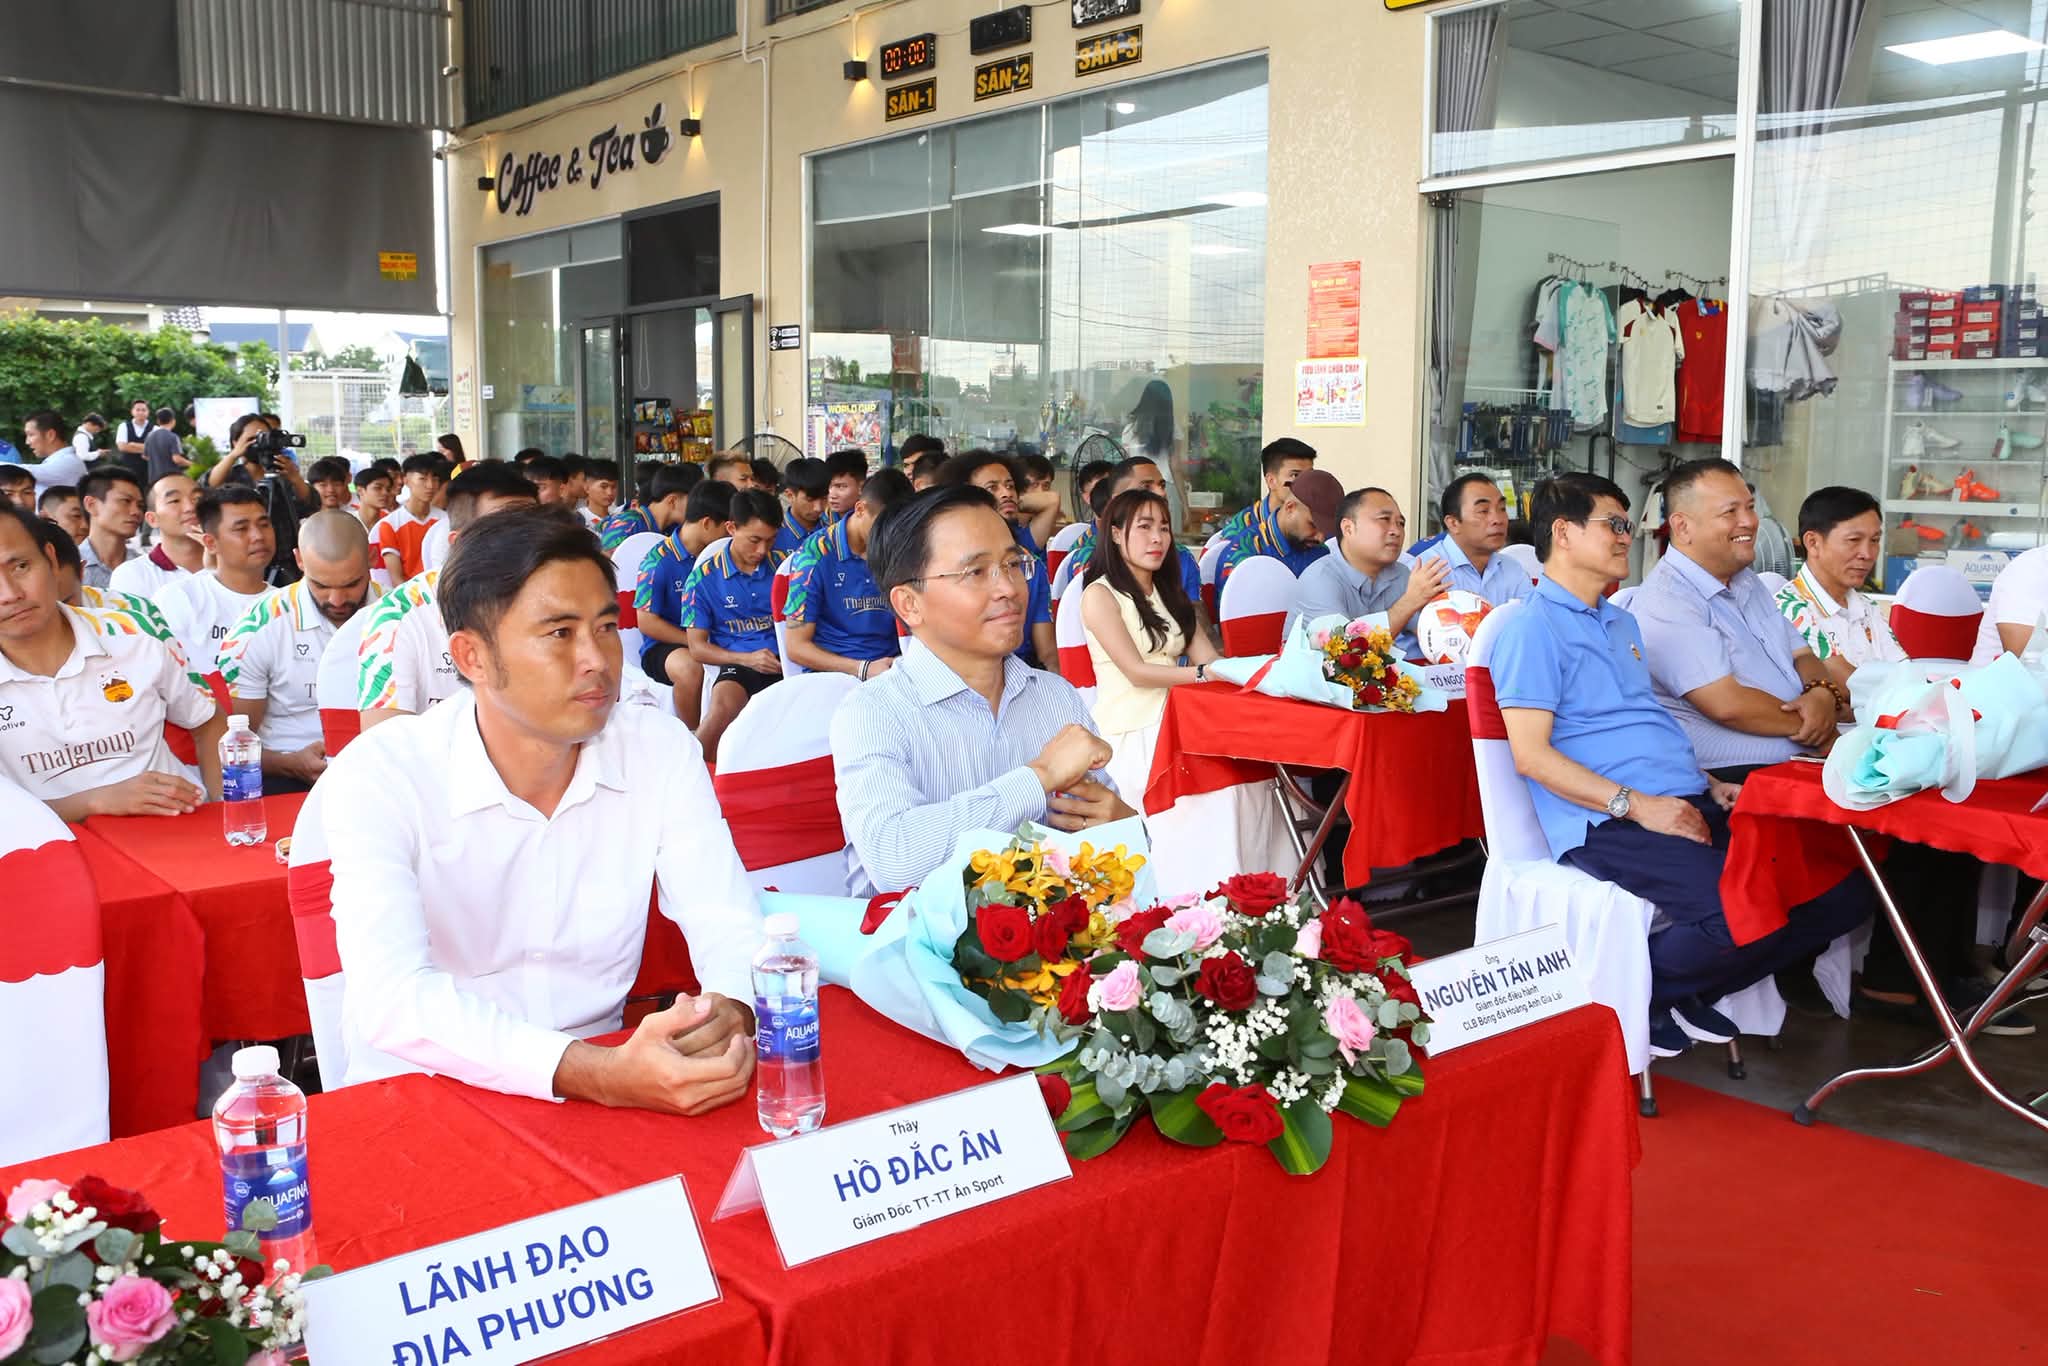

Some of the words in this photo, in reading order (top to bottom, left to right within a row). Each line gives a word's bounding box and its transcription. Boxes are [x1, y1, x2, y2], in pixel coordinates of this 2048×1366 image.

[885, 40, 925, 73] 00:00
[1078, 36, 1138, 71] SÂN-3
[976, 63, 1030, 95] SÂN-2
[888, 87, 934, 116] SÂN-1
[497, 152, 562, 216] Coffee
[566, 147, 583, 184] &
[589, 124, 636, 190] Tea
[828, 403, 858, 414] WORLD
[858, 403, 877, 413] CUP
[1424, 969, 1498, 1012] NGUYỄN
[1497, 957, 1534, 988] TẤN
[1536, 949, 1571, 977] ANH
[1462, 1018, 1478, 1031] CLB
[1528, 998, 1542, 1008] Anh
[1541, 994, 1553, 1005] Gia
[833, 1158, 882, 1202] HỒ
[887, 1141, 953, 1186] ĐẮC
[958, 1129, 1003, 1166] ÂN
[252, 1179, 309, 1208] UAFINA
[912, 1189, 951, 1211] TT-TT
[953, 1183, 972, 1199] Ân
[971, 1174, 1005, 1193] Sport
[398, 1250, 518, 1317] LÃNH
[525, 1225, 610, 1278] ĐẠO
[477, 1267, 655, 1350] PHƯƠNG
